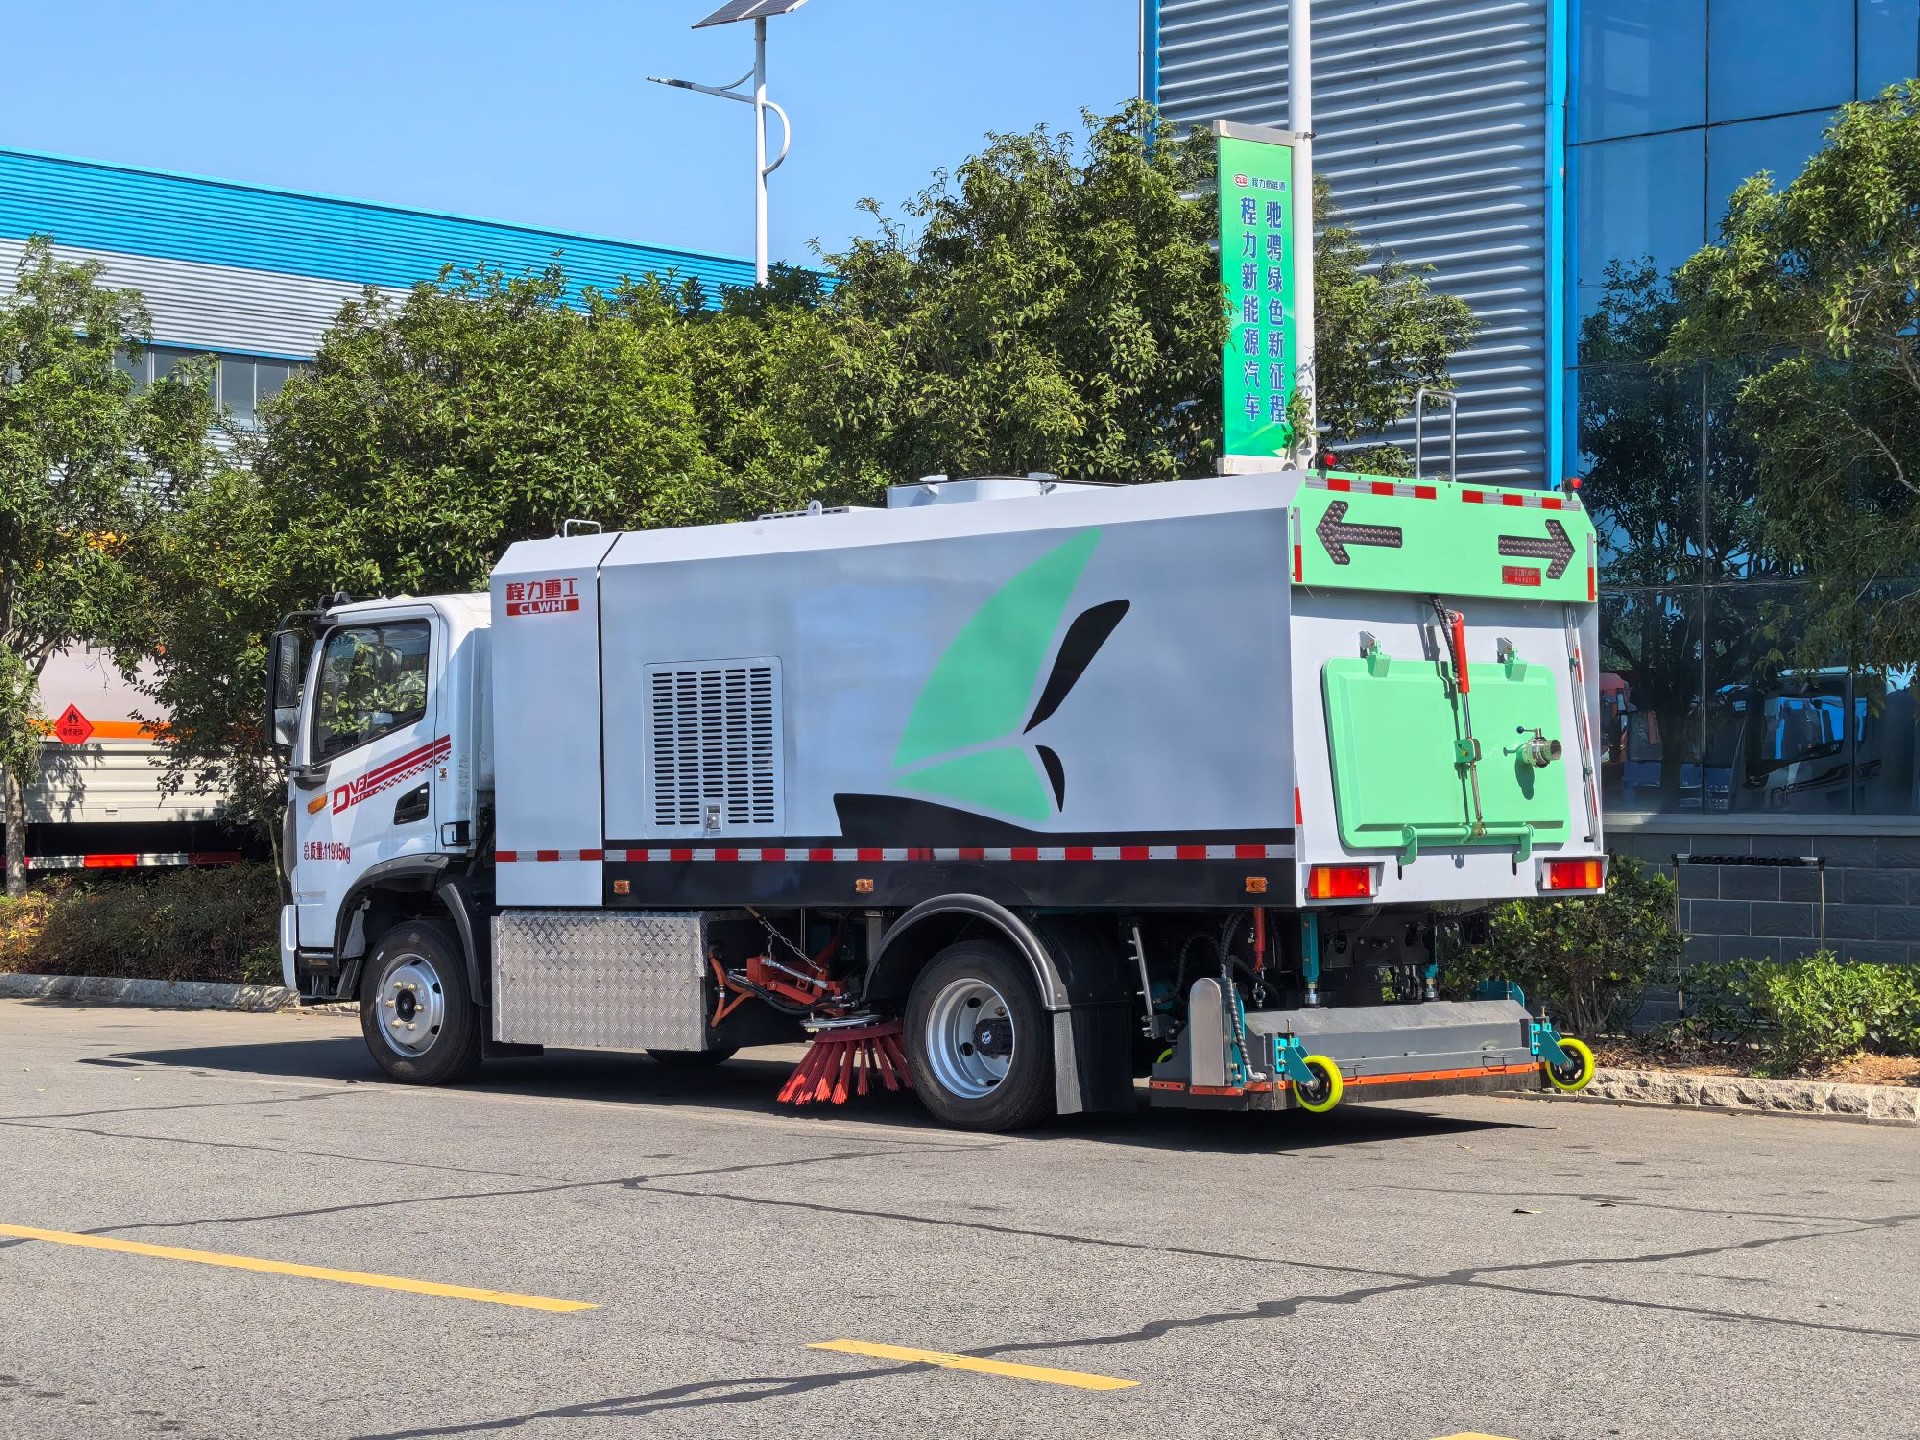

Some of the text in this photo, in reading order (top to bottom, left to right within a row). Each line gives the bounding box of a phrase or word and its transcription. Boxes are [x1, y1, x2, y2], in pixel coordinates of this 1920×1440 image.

[1241, 197, 1261, 421] 程力新能源汽车
[1266, 201, 1286, 423] 驰骋绿色新征程
[506, 578, 578, 601] 程力重工
[519, 600, 567, 614] CLWHI
